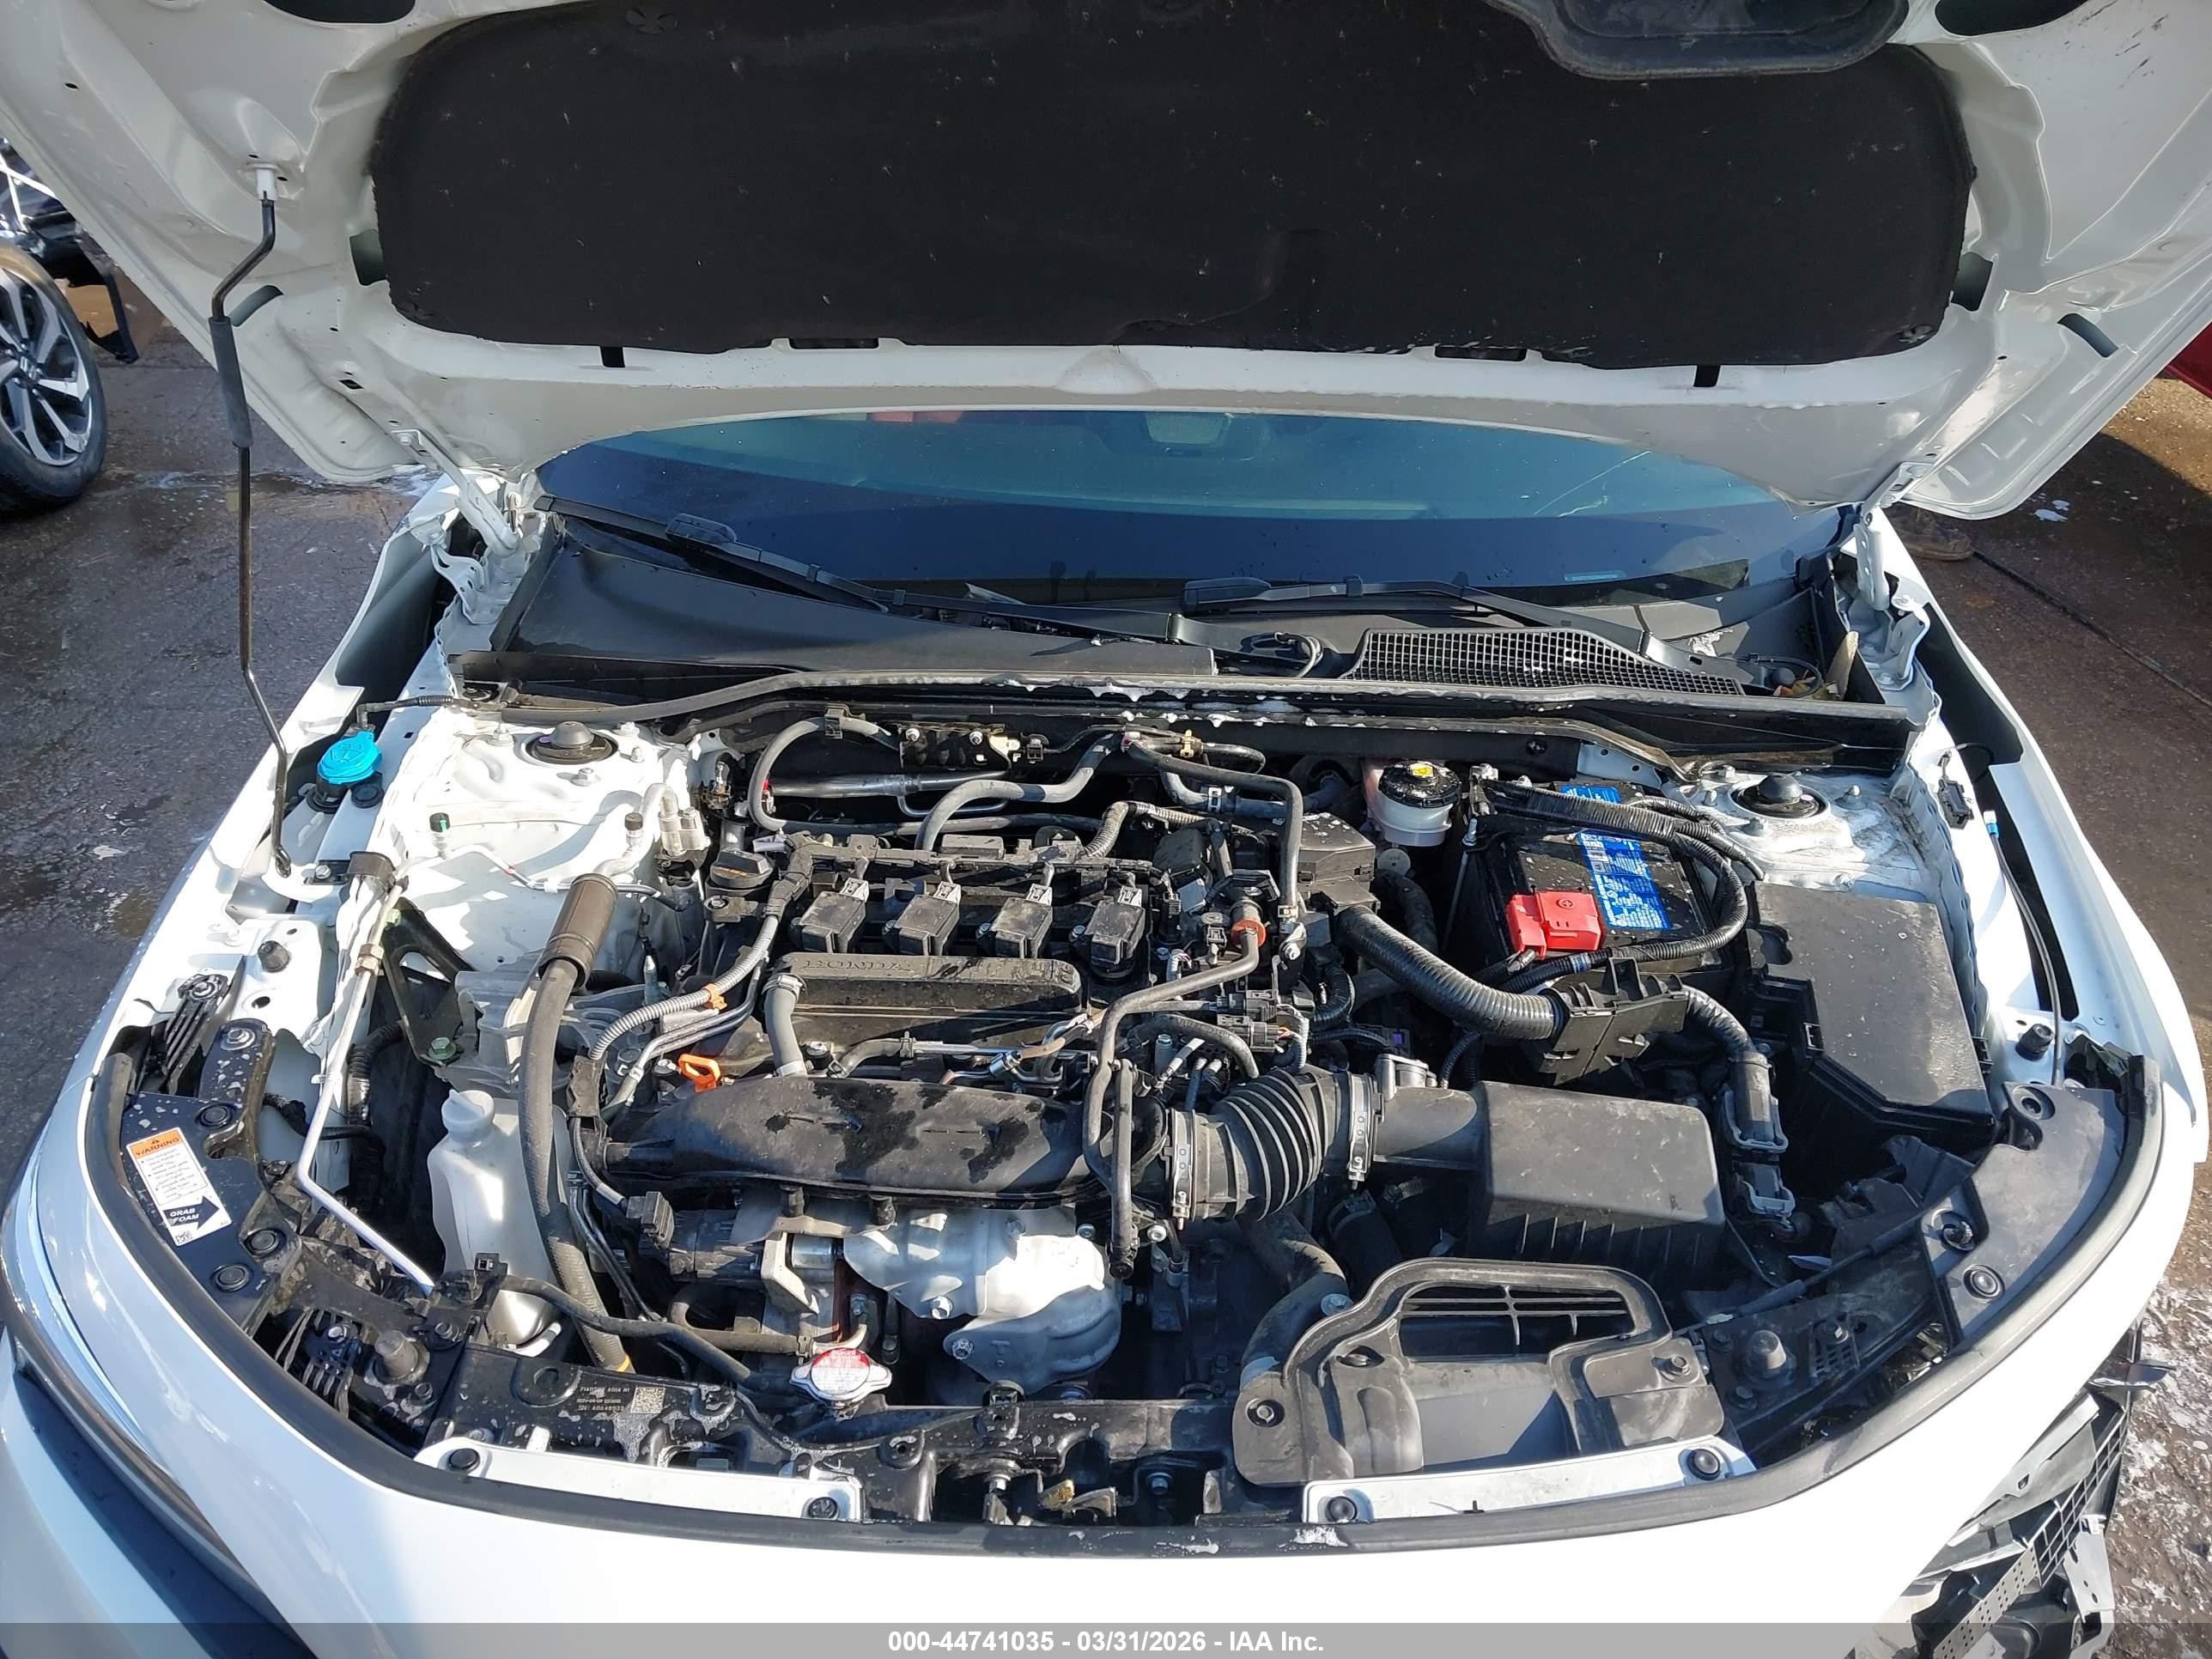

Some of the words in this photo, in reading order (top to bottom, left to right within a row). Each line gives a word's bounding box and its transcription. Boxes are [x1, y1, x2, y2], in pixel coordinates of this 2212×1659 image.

[800, 959, 912, 972] HONDA
[136, 1137, 179, 1156] WARNING
[170, 1207, 195, 1217] GRAB
[173, 1213, 199, 1224] FOAM
